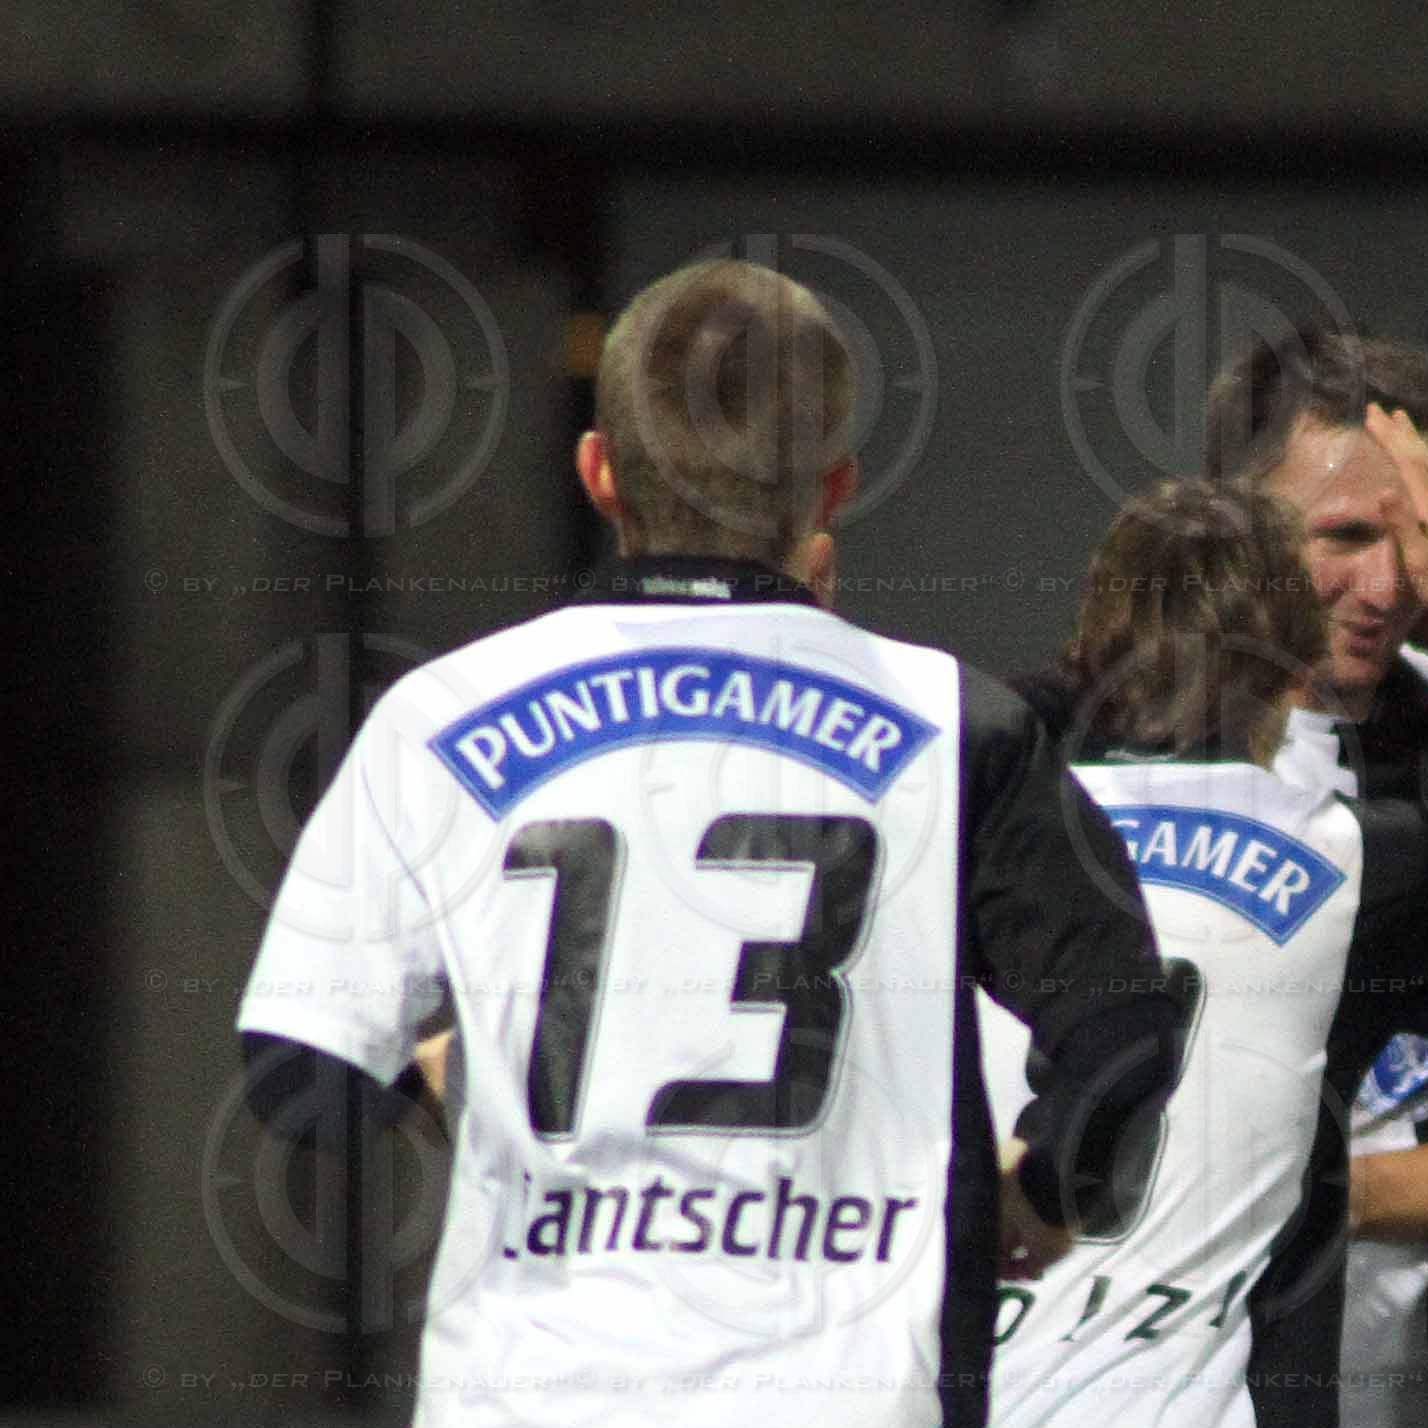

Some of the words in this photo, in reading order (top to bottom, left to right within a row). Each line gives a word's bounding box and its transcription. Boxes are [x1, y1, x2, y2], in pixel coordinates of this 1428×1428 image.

[455, 665, 902, 790] PUNTIGAMER
[503, 813, 886, 1142] 13
[503, 1170, 919, 1262] antscher
